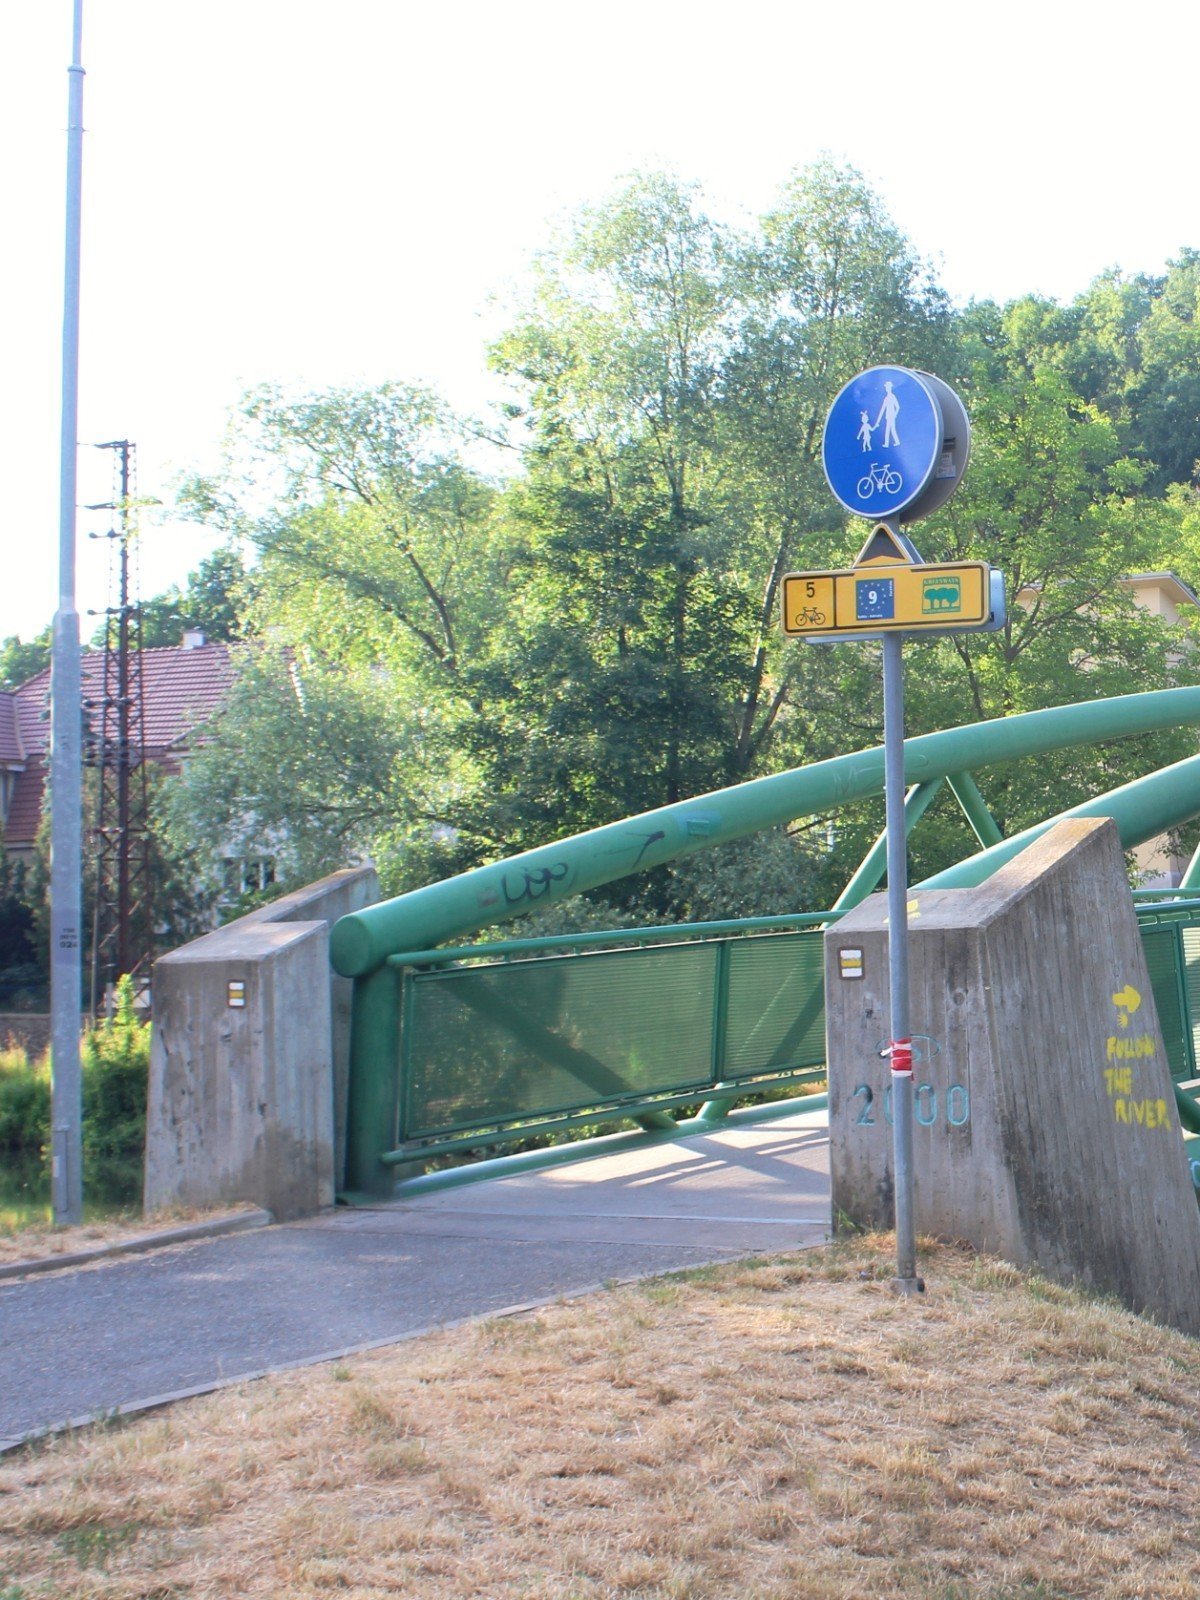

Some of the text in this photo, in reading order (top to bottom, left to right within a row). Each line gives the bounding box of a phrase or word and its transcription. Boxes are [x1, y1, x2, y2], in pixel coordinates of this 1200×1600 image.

[806, 581, 816, 598] 5
[868, 590, 878, 604] 9
[1106, 1034, 1155, 1061] FOLLOW
[1103, 1067, 1132, 1097] THE
[1115, 1098, 1171, 1131] RIVER
